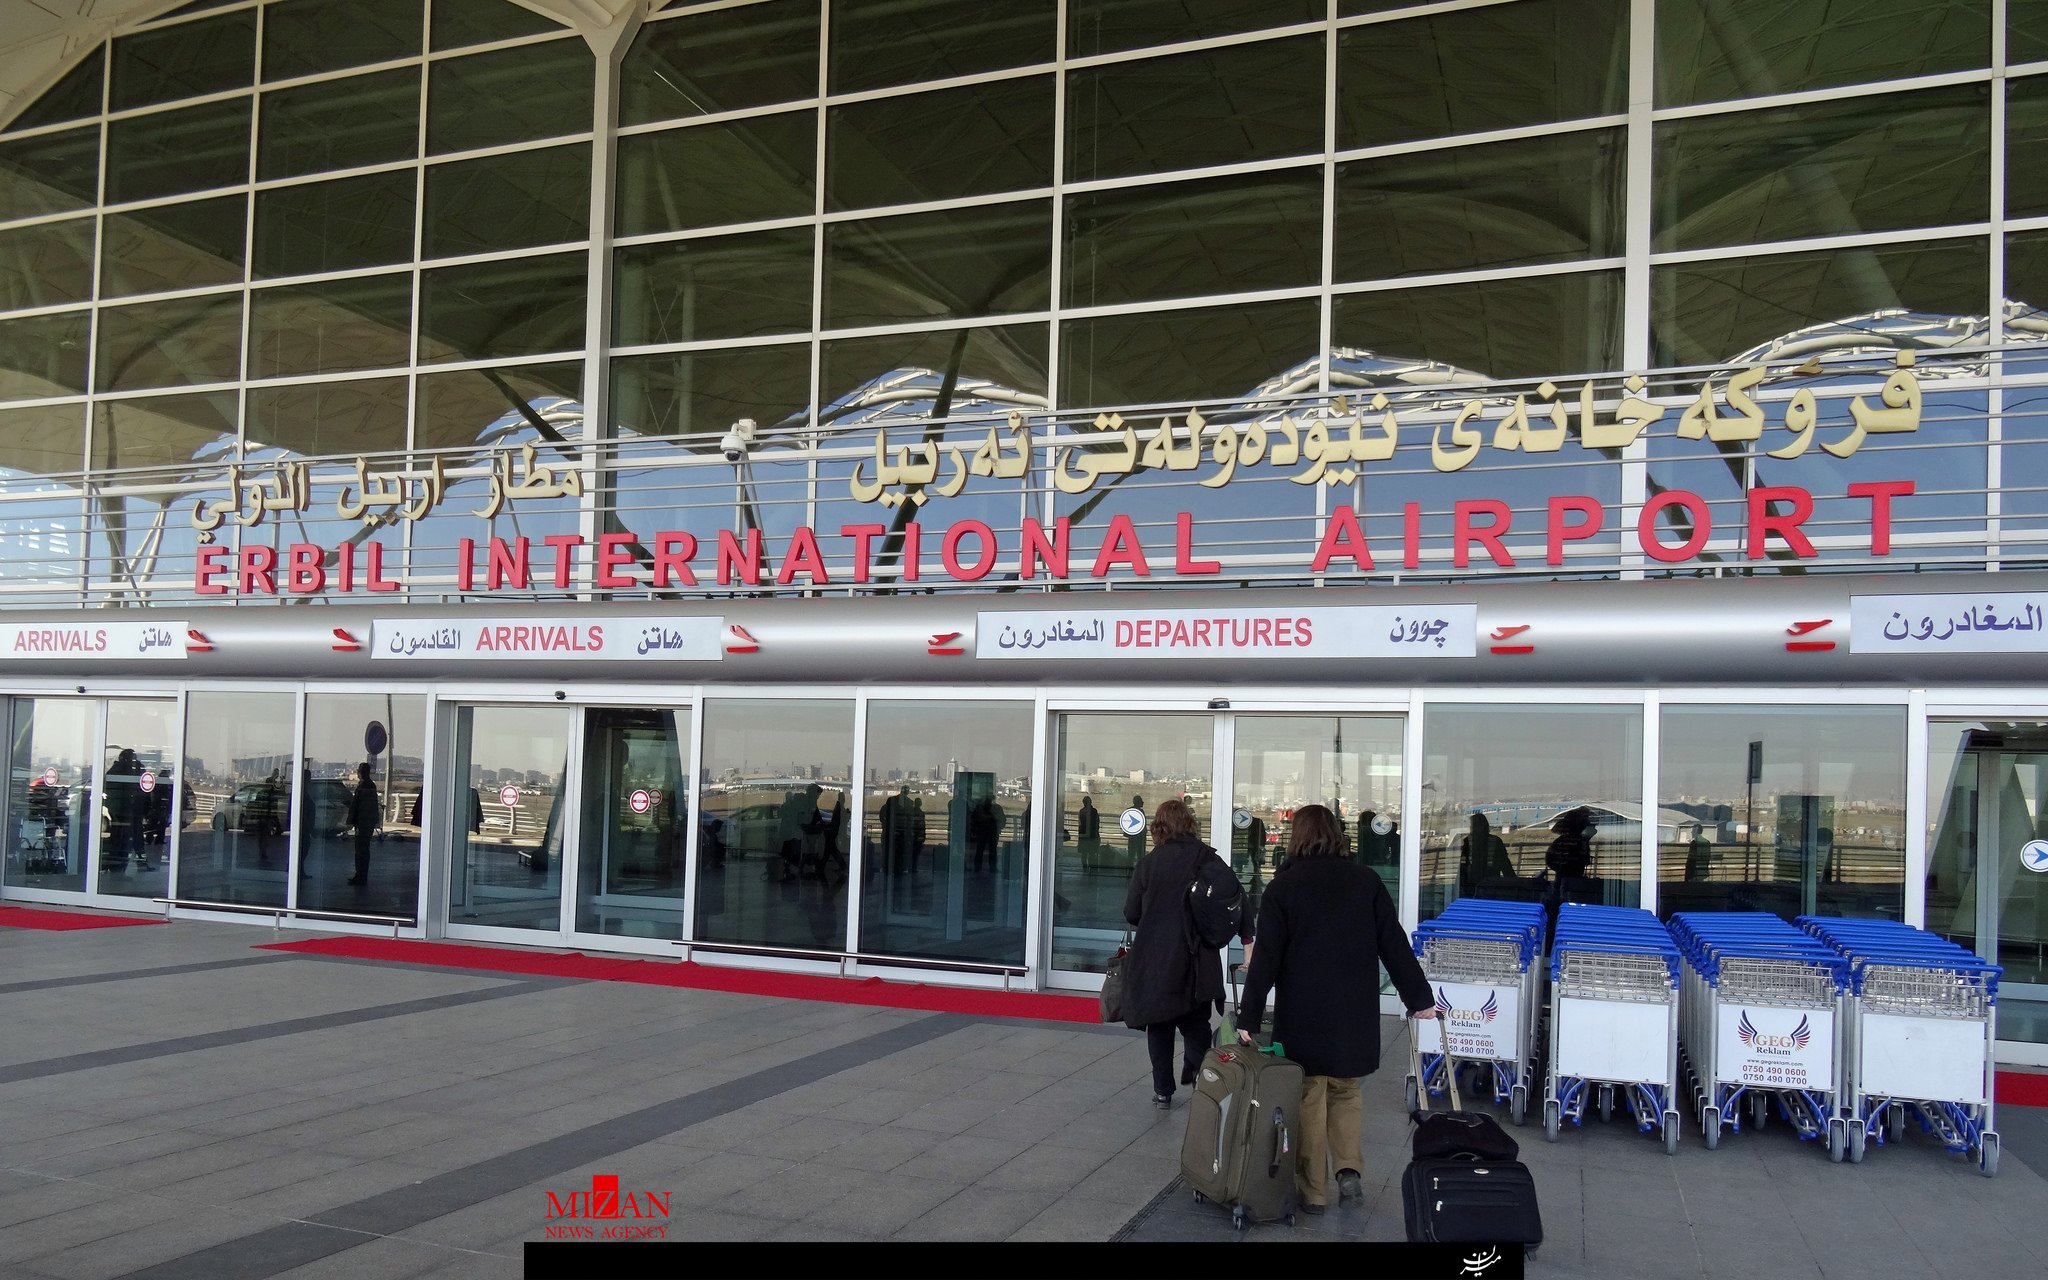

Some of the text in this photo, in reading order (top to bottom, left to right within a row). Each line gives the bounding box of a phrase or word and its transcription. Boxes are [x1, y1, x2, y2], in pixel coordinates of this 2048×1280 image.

[471, 442, 584, 519] مطار
[191, 460, 311, 545] الدولي
[195, 480, 1917, 595] ERBIL INTERNATIONAL AIRPORT
[1115, 617, 1313, 648] DEPARTURES
[1883, 603, 2043, 641] المغادرون
[14, 629, 107, 651] ARRIVALS
[138, 627, 173, 652] هاتن
[390, 627, 462, 655] القادمون
[476, 625, 604, 651] ARRIVALS
[637, 626, 684, 655] هاتن
[998, 620, 1104, 649] المغادرون
[1450, 1008, 1481, 1021] GEG
[1451, 1020, 1481, 1028] Reklam
[1440, 1036, 1457, 1044] 050
[1475, 1039, 1494, 1047] 0600
[1445, 1031, 1491, 1039] ww.gegreklam.com
[1756, 1034, 1791, 1048] GEG
[1440, 1044, 1458, 1052] 050
[1476, 1047, 1495, 1055] 0700
[1756, 1047, 1791, 1056] Reklam
[1742, 1064, 1807, 1077] 0750 490 0600
[1747, 1059, 1804, 1067] www.gegreklam.com
[1743, 1073, 1807, 1085] 0750 490 0700
